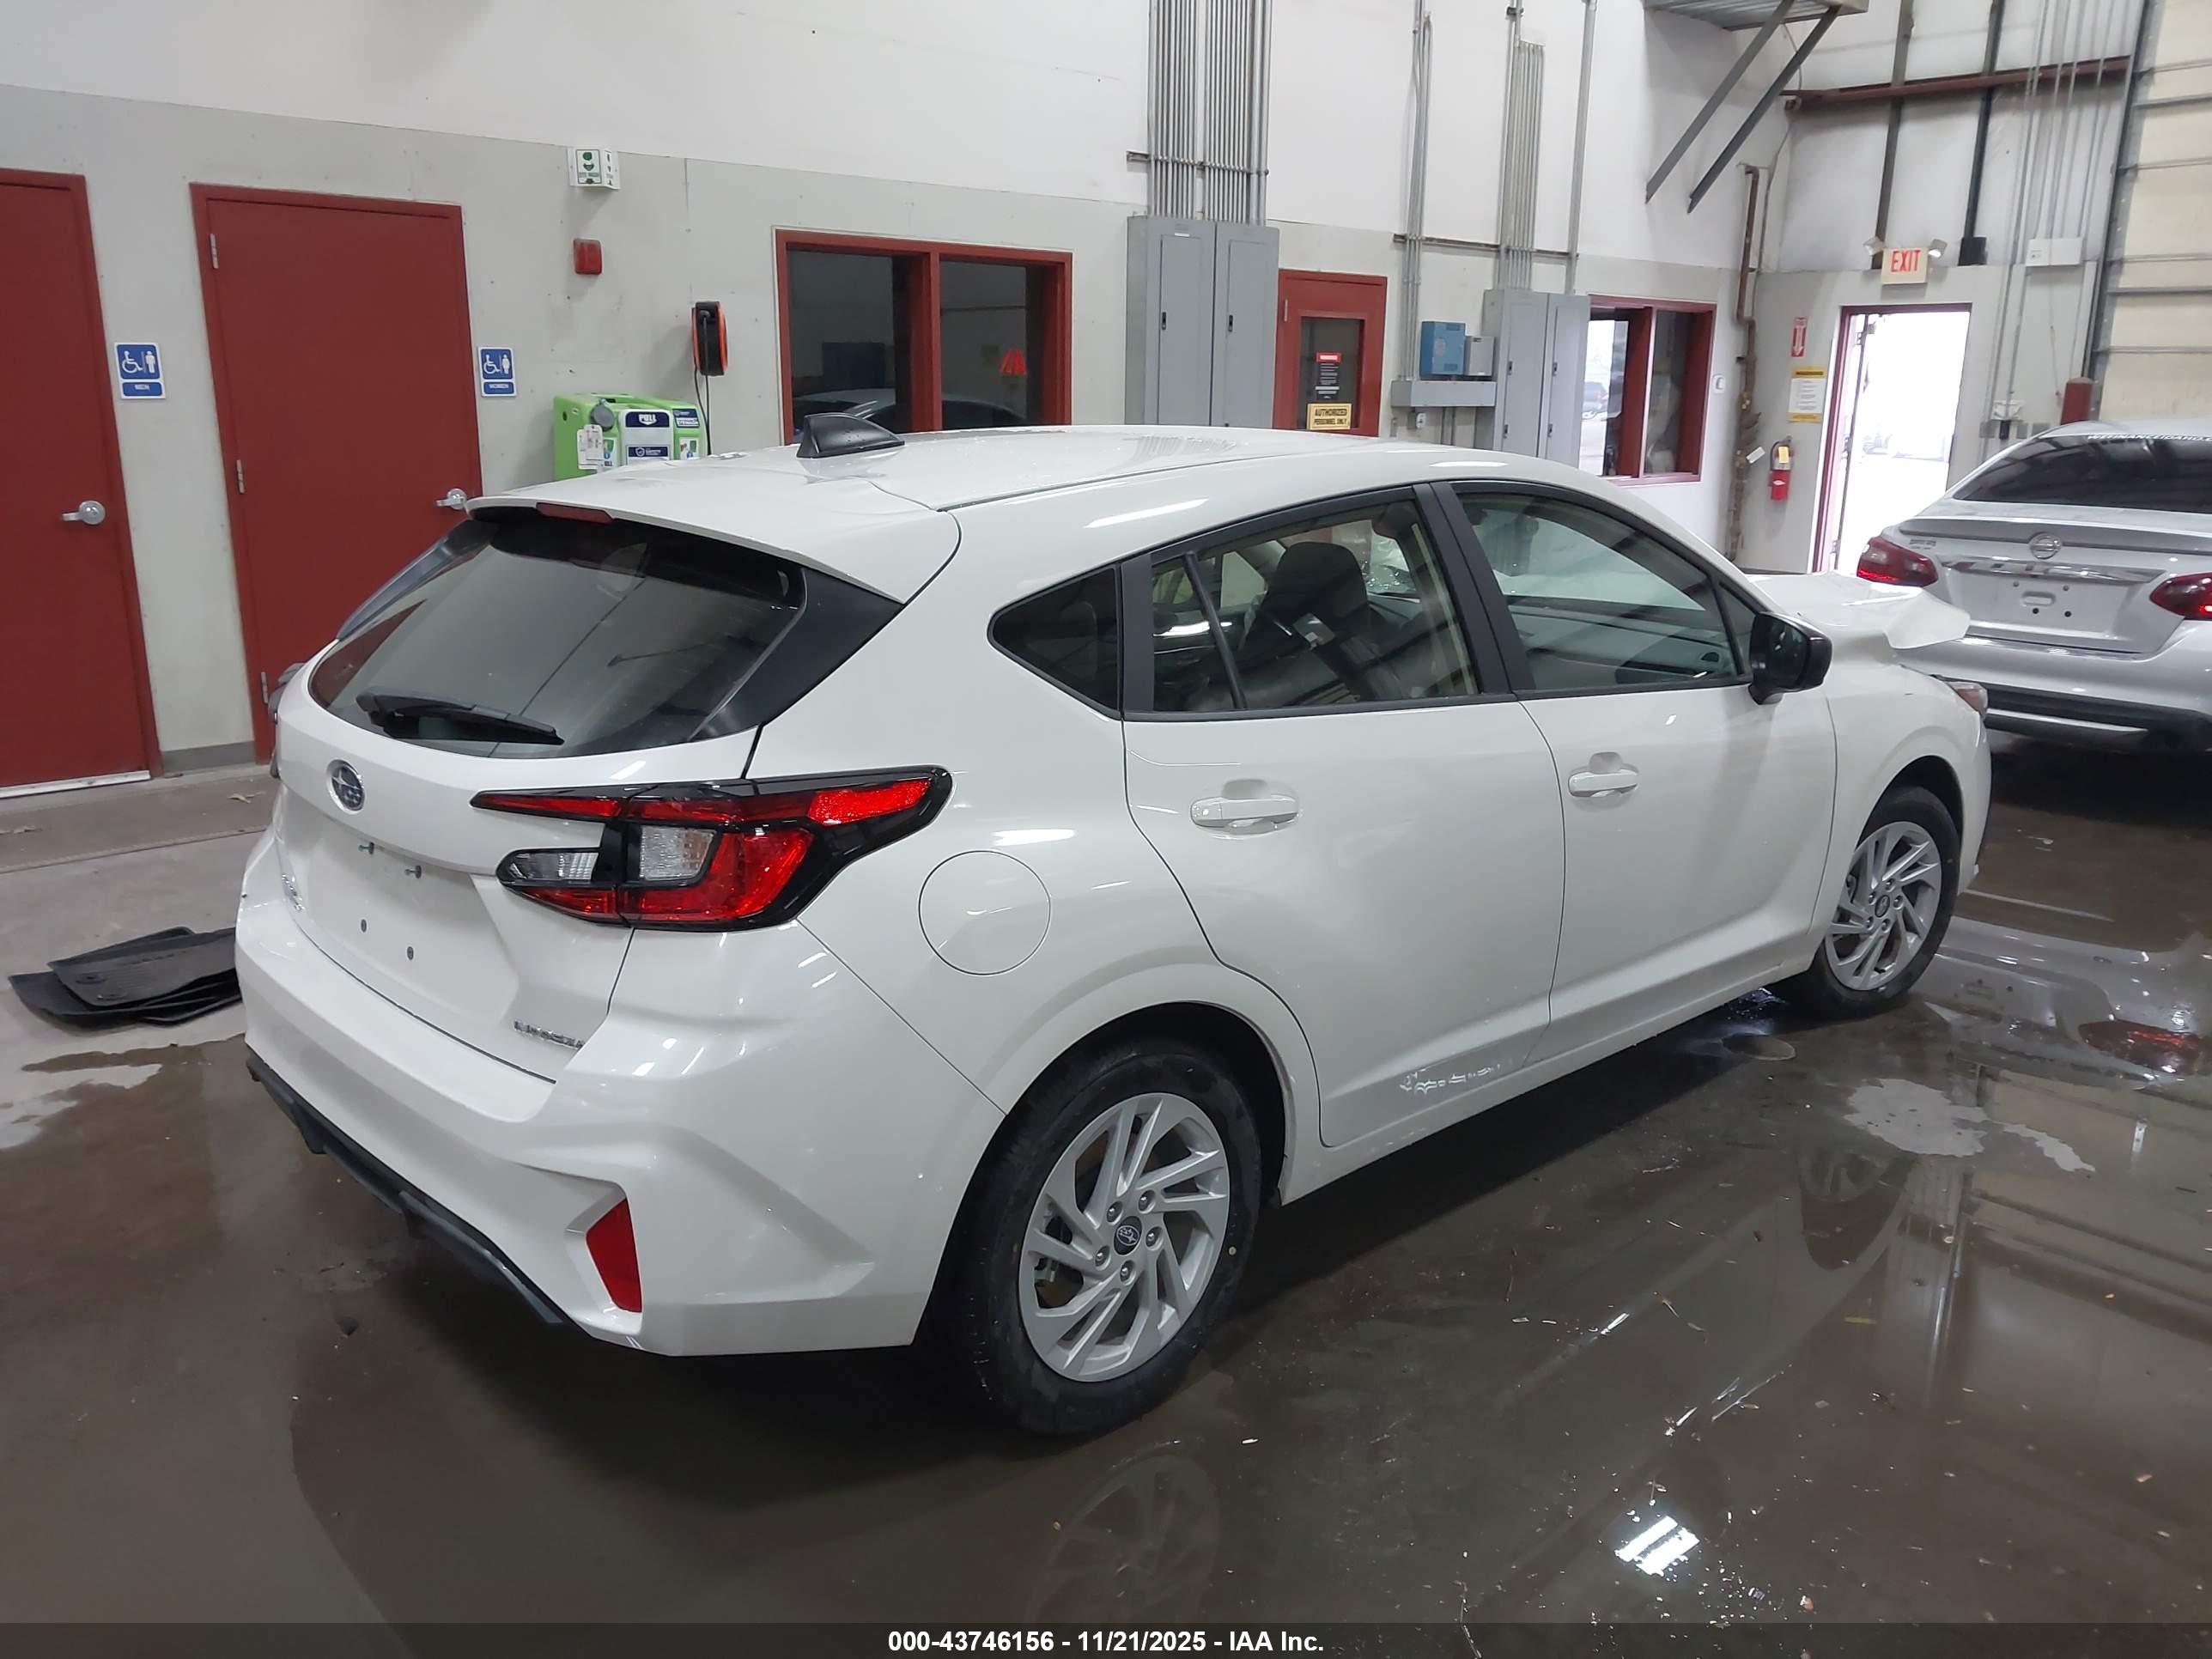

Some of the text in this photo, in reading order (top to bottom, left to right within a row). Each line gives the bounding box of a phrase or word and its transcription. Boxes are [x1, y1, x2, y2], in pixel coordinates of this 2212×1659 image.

[1891, 249, 1921, 272] EXIT
[1314, 408, 1348, 416] AUTHORIZED
[638, 413, 657, 425] PULL
